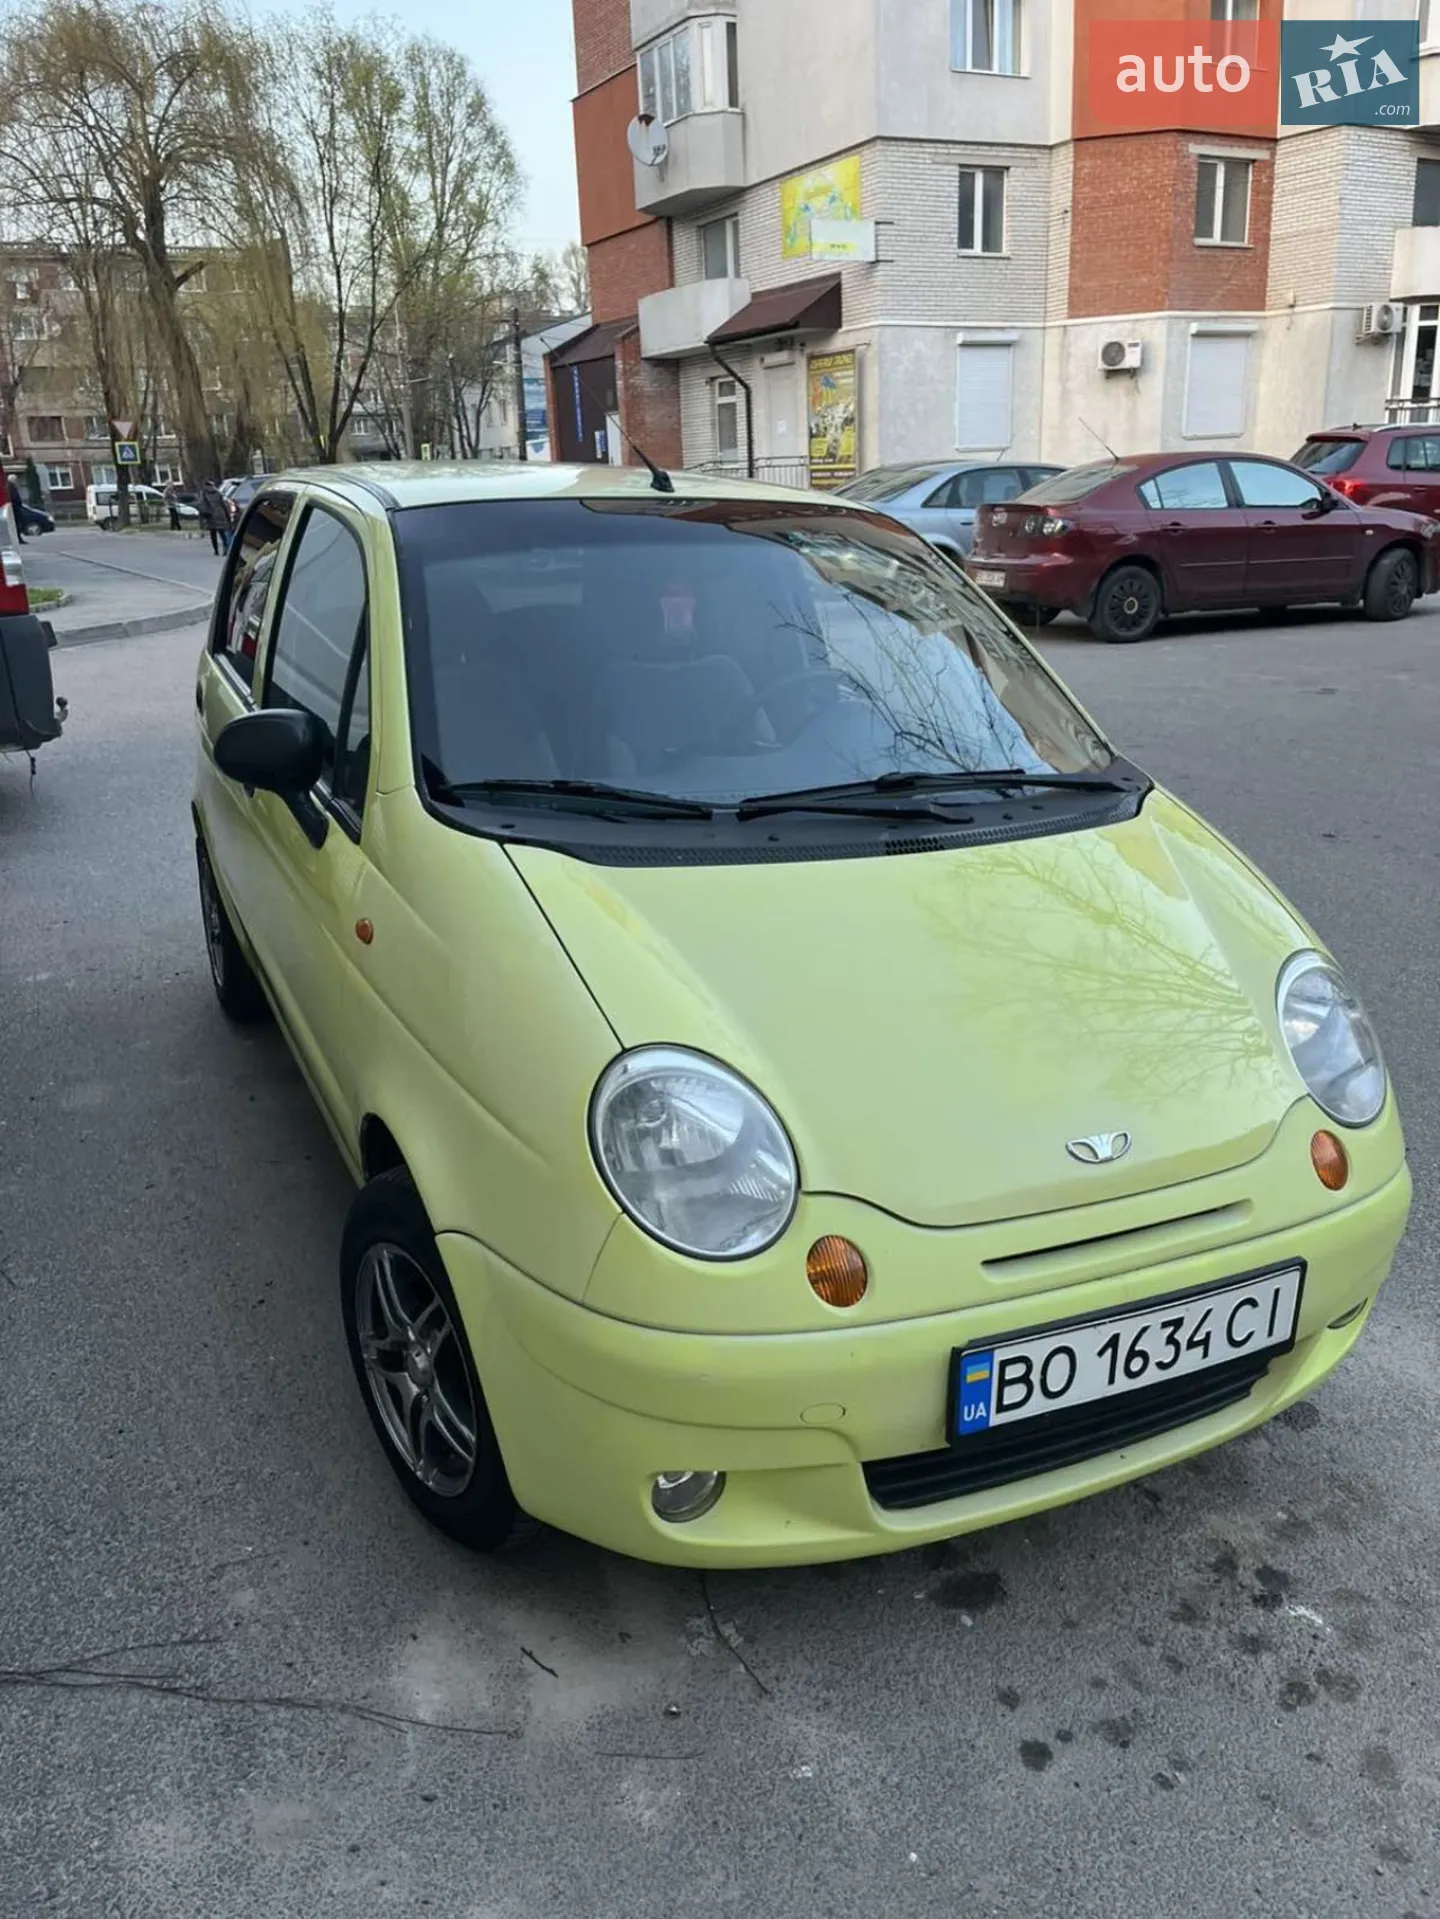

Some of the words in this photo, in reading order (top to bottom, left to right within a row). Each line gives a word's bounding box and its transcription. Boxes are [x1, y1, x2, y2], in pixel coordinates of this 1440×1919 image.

[995, 1345, 1077, 1415] BO
[1096, 1307, 1215, 1386] 1634
[963, 1401, 988, 1422] UA
